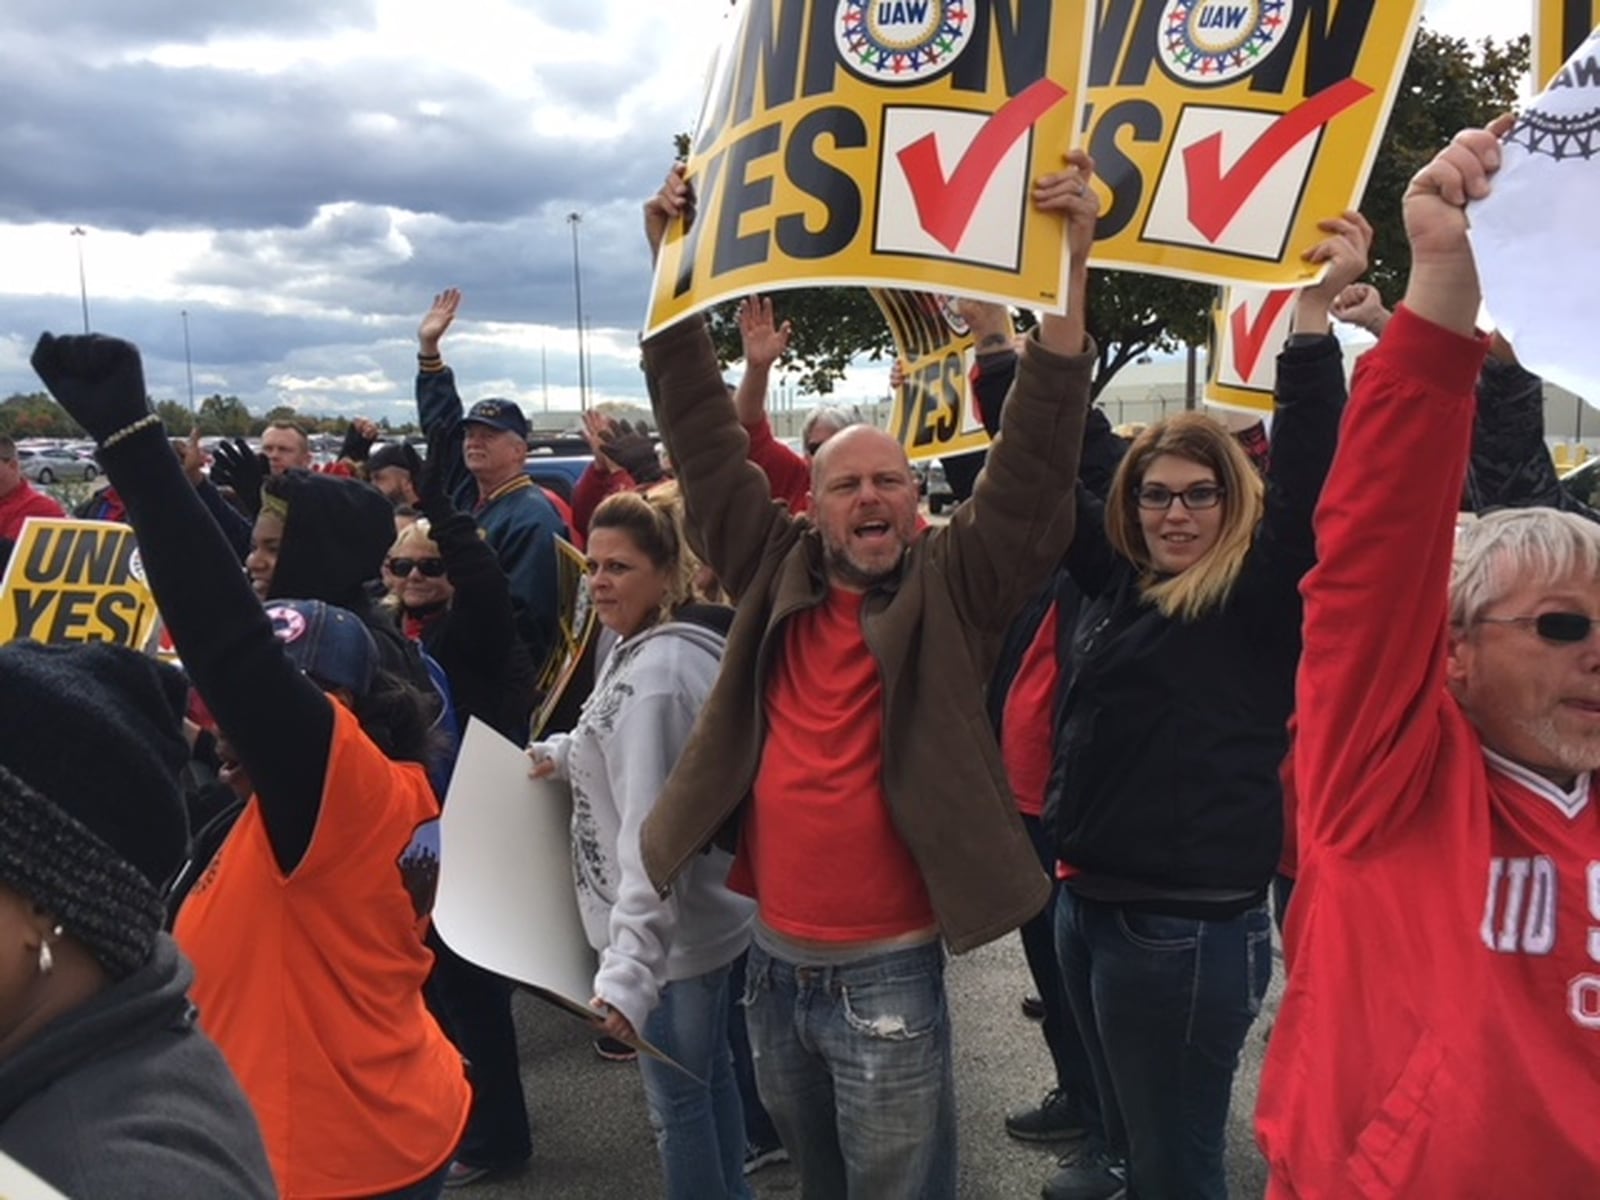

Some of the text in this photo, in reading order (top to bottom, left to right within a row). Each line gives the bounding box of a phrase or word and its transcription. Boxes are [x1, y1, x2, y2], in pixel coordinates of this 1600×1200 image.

[877, 0, 927, 25] UAW
[1198, 5, 1247, 29] UAW
[673, 105, 868, 300] YES
[12, 588, 138, 646] YES
